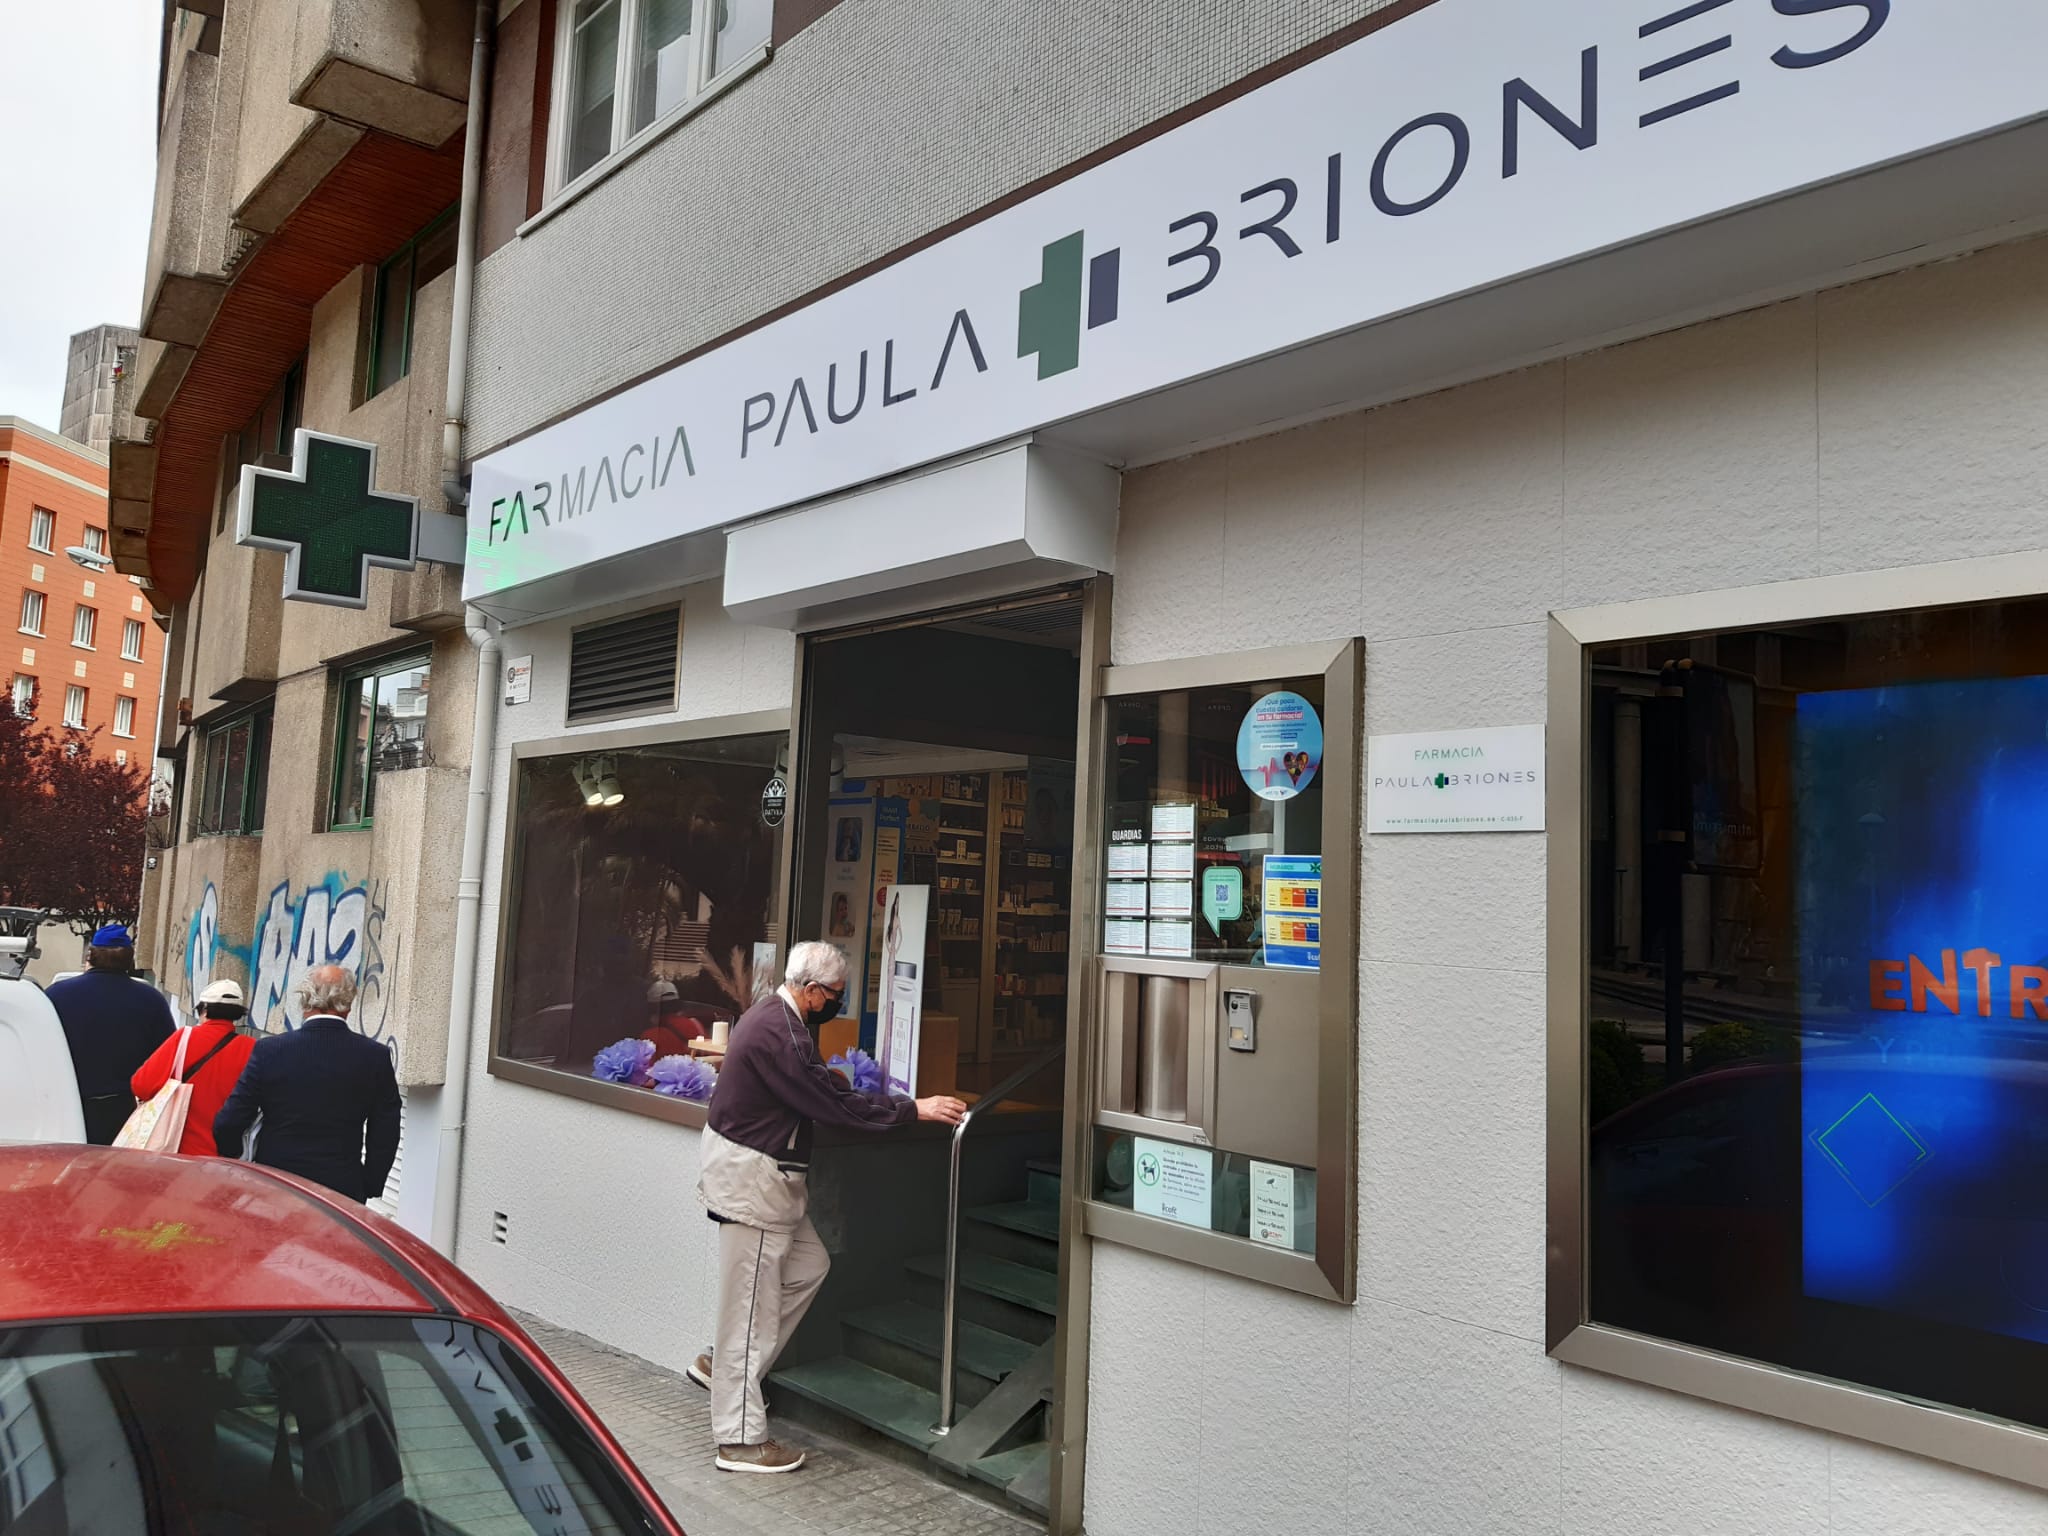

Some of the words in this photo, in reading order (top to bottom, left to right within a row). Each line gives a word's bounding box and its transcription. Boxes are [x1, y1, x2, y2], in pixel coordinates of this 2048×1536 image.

[489, 425, 696, 547] FARMACIA
[740, 308, 988, 459] PAULA
[1166, 0, 1892, 304] BRIONES
[1414, 746, 1484, 761] FARMACIA
[1375, 775, 1432, 789] PAULA
[1449, 770, 1536, 786] BRIONES
[1112, 829, 1142, 841] GUARDIAS
